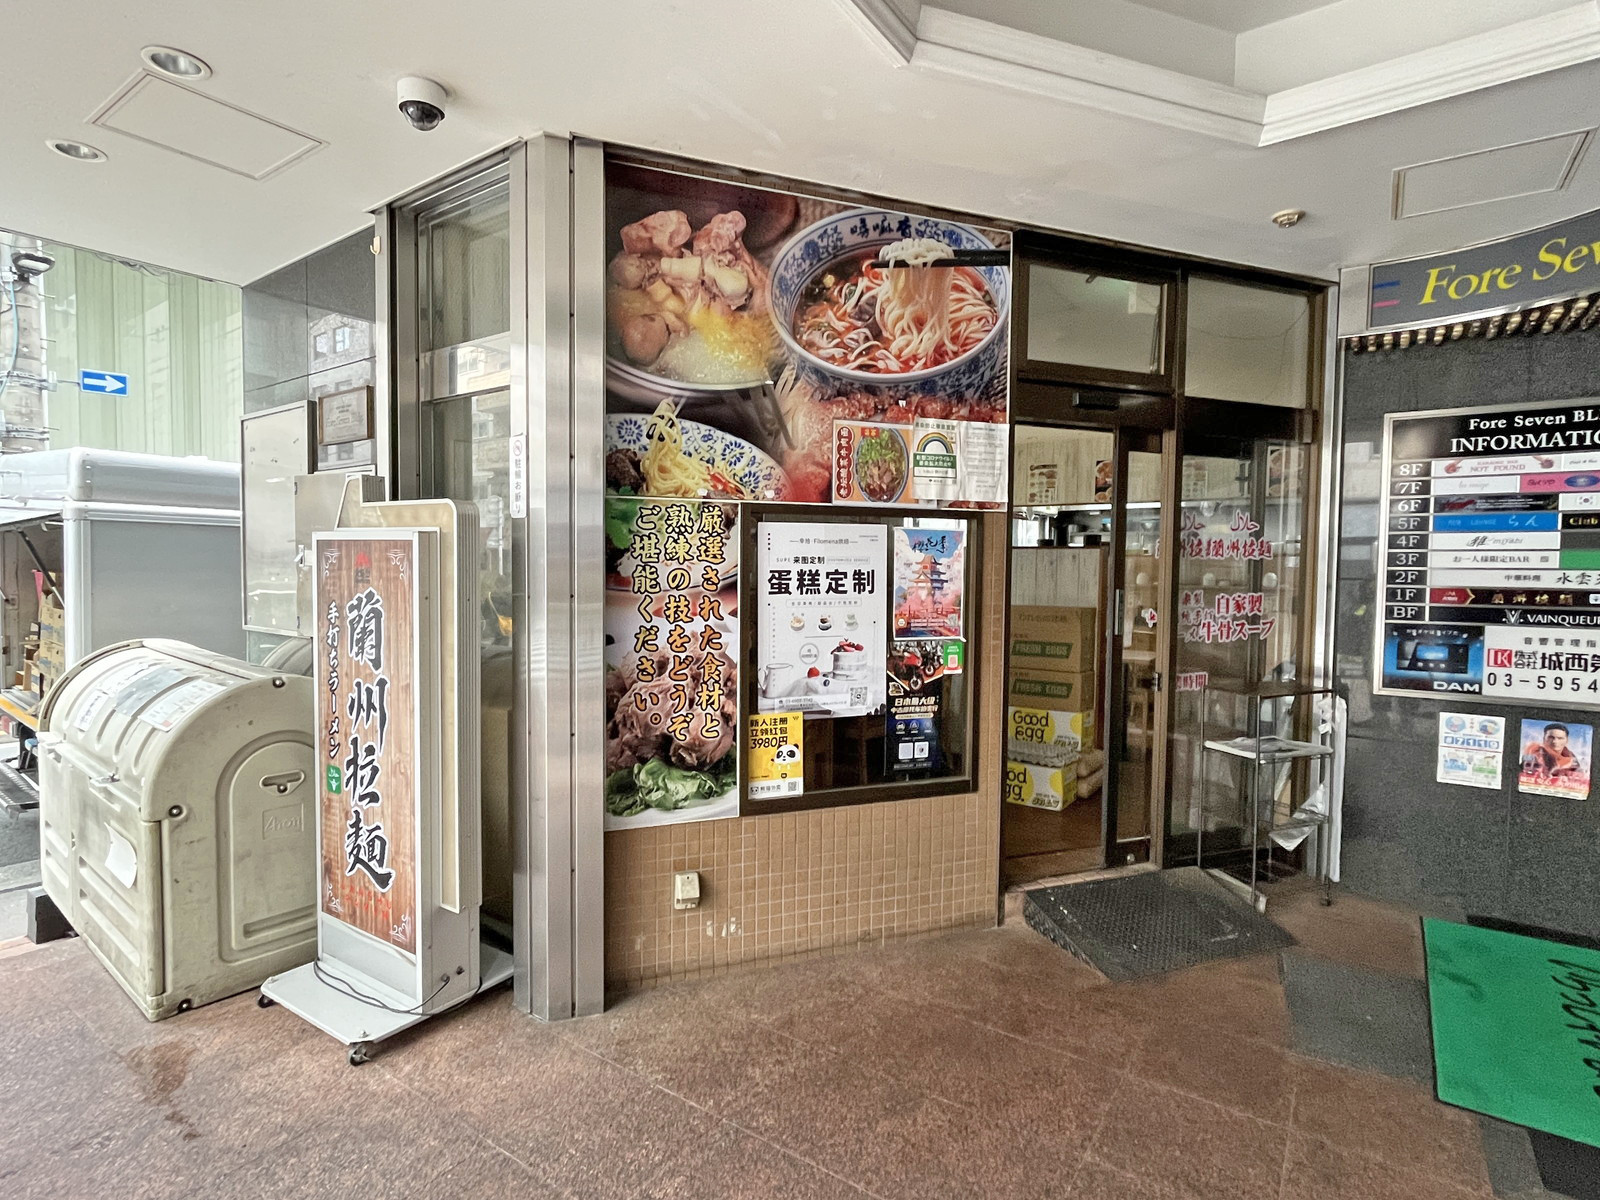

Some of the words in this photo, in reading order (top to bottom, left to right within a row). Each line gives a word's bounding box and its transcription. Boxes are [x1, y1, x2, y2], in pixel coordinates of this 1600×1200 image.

[1418, 264, 1522, 305] Fore
[1469, 418, 1507, 430] Fore
[1514, 414, 1566, 427] Seven
[1572, 409, 1600, 422] BL
[1399, 463, 1423, 476] 8F
[1494, 464, 1526, 472] FOUND
[1398, 481, 1423, 494] 7F
[1397, 499, 1422, 512] 6F
[1398, 517, 1421, 530] 5F
[1569, 513, 1598, 525] Club
[1396, 535, 1420, 547] 4F
[793, 556, 825, 564] 来图定制
[1396, 553, 1420, 565] 3F
[768, 568, 875, 596] 蛋糕定制
[1395, 571, 1419, 583] 2F
[1504, 574, 1541, 582] 中華料理
[1395, 589, 1417, 601] 1F
[1217, 594, 1263, 616] 自家製
[631, 505, 662, 726] ご堪能ください。
[1393, 606, 1418, 618] BF
[664, 503, 695, 742] 熟練の技をどうぞ
[697, 505, 726, 739] 厳選された食材と
[1202, 618, 1275, 643] 牛骨スープ
[326, 601, 340, 759] 手打ちラーメン
[1433, 680, 1480, 692] DAM
[750, 717, 788, 727] 新人注册
[1013, 710, 1049, 727] Good
[750, 727, 788, 737] 立领红包
